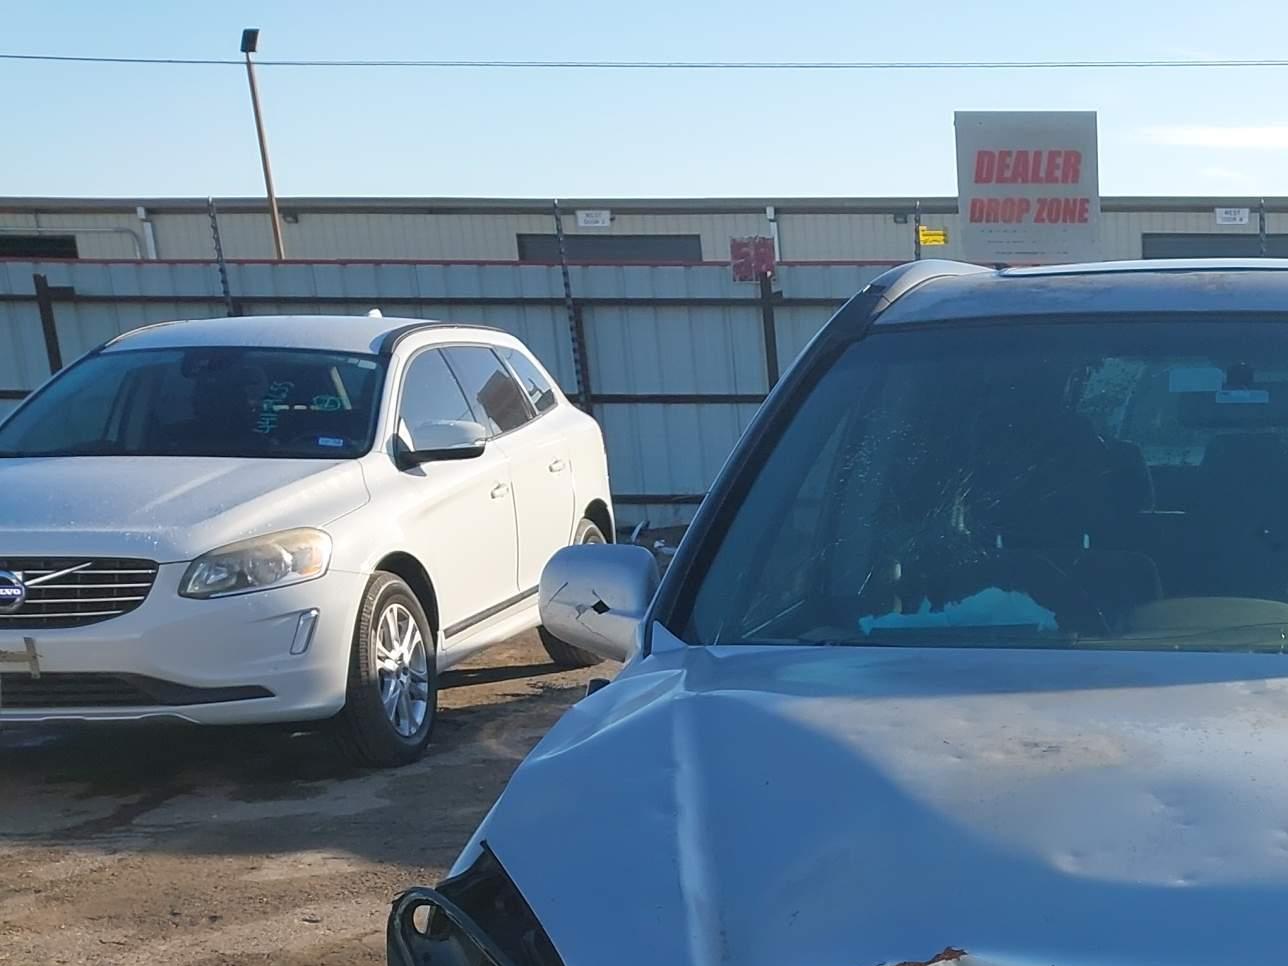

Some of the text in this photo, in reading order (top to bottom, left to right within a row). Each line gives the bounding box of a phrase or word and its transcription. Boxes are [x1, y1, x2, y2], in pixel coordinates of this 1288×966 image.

[974, 150, 1082, 184] DEALER
[969, 198, 1089, 224] DROP ZONE
